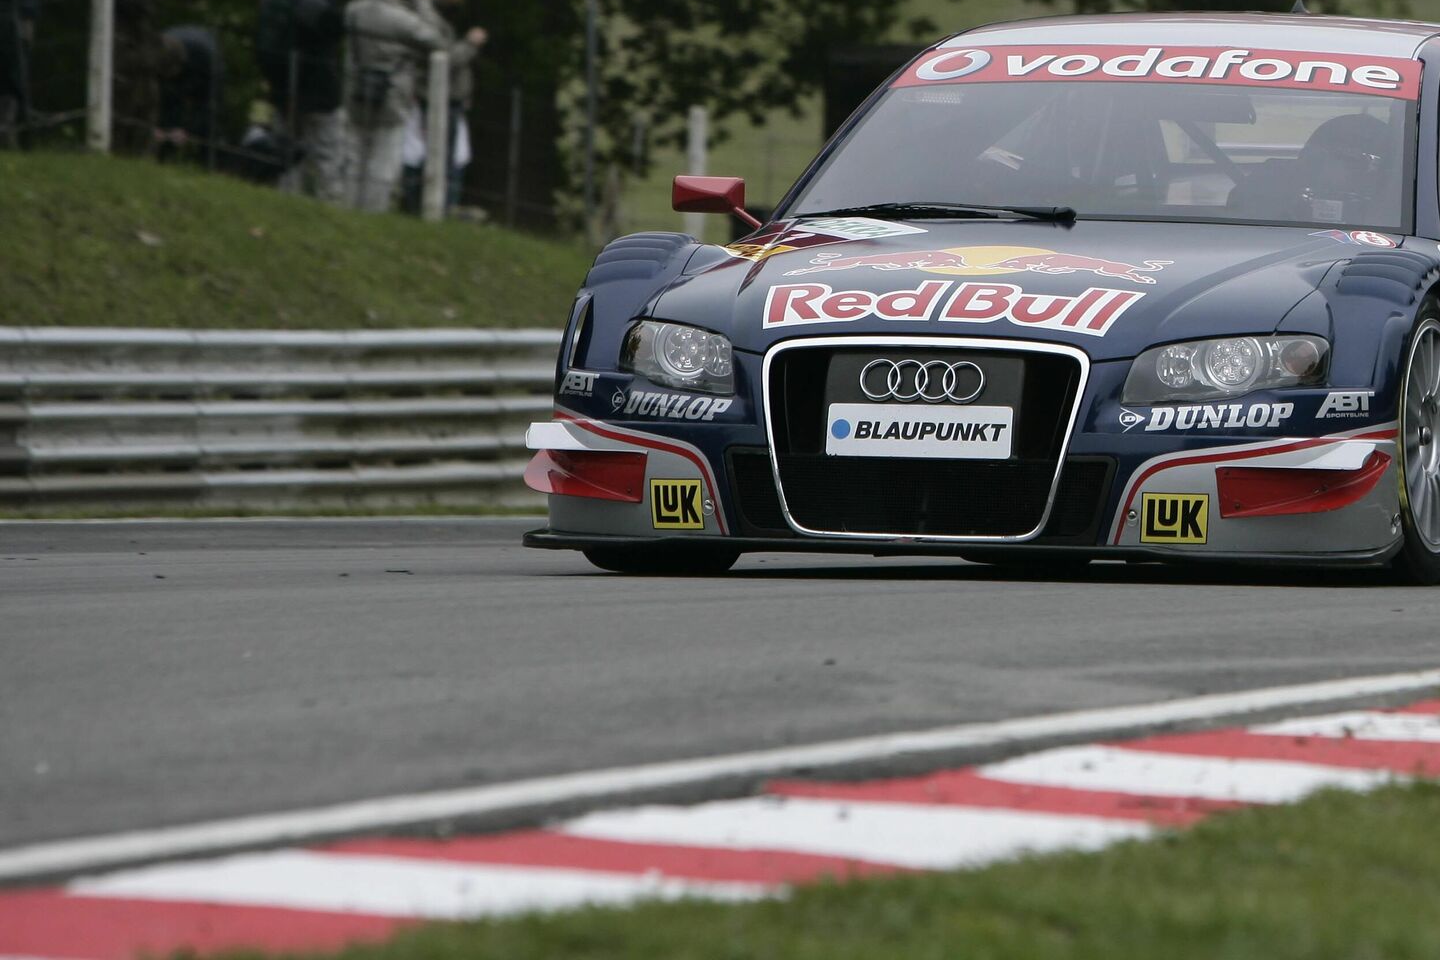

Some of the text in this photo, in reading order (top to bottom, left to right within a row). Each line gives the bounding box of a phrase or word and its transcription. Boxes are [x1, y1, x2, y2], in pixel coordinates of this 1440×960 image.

[1007, 47, 1400, 89] vodafone
[767, 281, 1140, 332] Red Bull
[559, 371, 600, 394] ABT
[623, 391, 733, 421] DUNLOP
[1145, 402, 1295, 432] DUNLOP
[1315, 391, 1375, 418] ABT
[854, 421, 1007, 442] BLAUPUNKT
